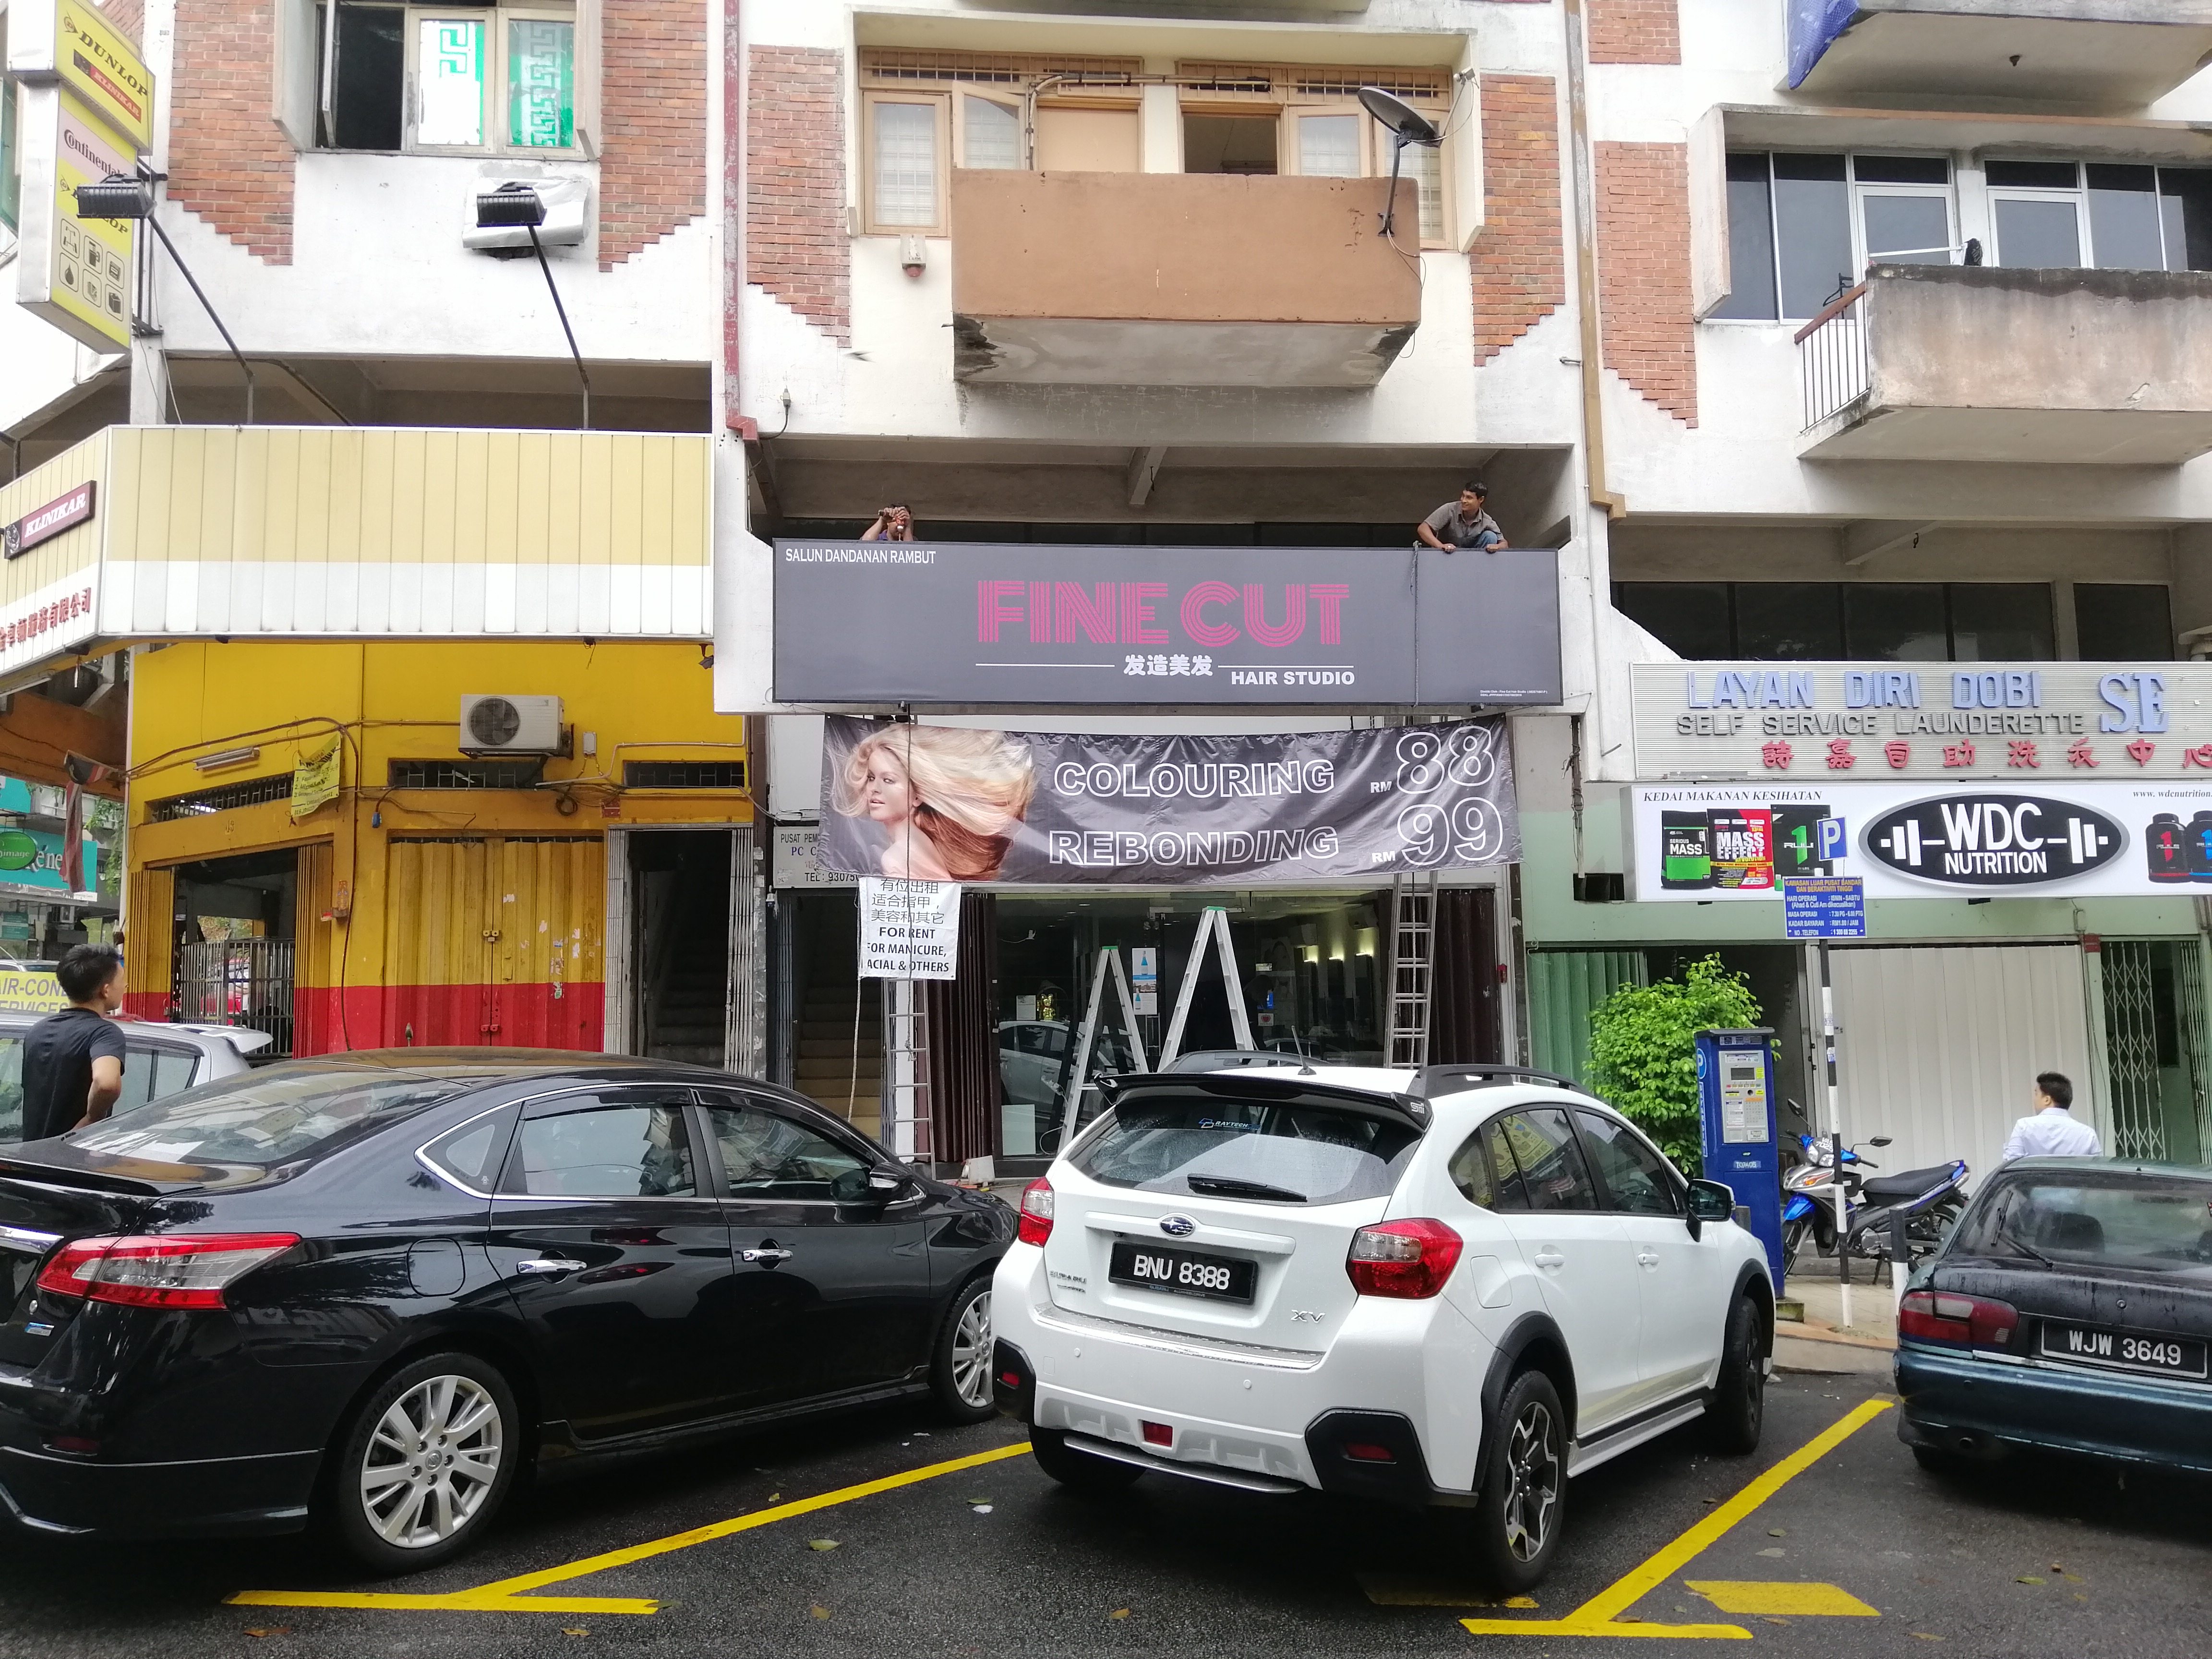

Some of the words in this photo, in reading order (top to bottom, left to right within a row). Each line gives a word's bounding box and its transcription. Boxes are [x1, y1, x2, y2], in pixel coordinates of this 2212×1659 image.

[79, 30, 148, 96] DUNLOP
[93, 72, 140, 118] KLINIKAR
[24, 493, 86, 538] KLINIKAR
[785, 548, 823, 562] SALUN
[825, 549, 888, 564] DANDANAN
[890, 550, 936, 564] RAMBUT
[978, 580, 1169, 644] FINE
[1180, 580, 1349, 648] CUT
[1123, 654, 1213, 676] 发造美发
[1231, 672, 1278, 685] HAIR
[1283, 672, 1355, 685] STUDIO
[1688, 671, 1815, 709] LAYAN
[1845, 670, 1920, 709] DIRI
[1953, 671, 2041, 709] DOBI
[2099, 672, 2170, 733] SE
[1677, 714, 1746, 737] SELF
[1763, 713, 1878, 737] SERVICE
[1895, 713, 2085, 736] LAUNDERETTE
[1370, 781, 1392, 794] RM
[1395, 725, 1495, 794] 88
[1054, 759, 1334, 798] COLOURING
[1643, 792, 1683, 802] KEDAI
[1685, 792, 1750, 801] MAKANAN
[1752, 791, 1822, 801] KESIHATAN
[1371, 851, 1396, 863] RM
[1396, 797, 1503, 865] 99
[1941, 802, 2044, 851] WDC
[781, 834, 801, 843] PUSAT
[1049, 827, 1339, 866] REBONDING
[1717, 831, 1765, 847] MASS
[1823, 820, 1840, 858] P
[792, 847, 804, 856] PC
[1670, 844, 1703, 854] MASS
[1717, 846, 1765, 860] EFFECT
[1945, 852, 2047, 874] NUTRITION
[880, 878, 939, 894] 有位出租
[871, 909, 944, 924] 美容和其它
[879, 927, 905, 937] FOR
[908, 928, 935, 938] RENT
[888, 944, 947, 957] MANICURE,
[866, 959, 895, 970] ACIAL
[898, 961, 906, 971] &
[910, 961, 949, 972] OTHERS
[0, 978, 67, 996] IR-CON
[1050, 1270, 1086, 1284] SUBARU
[1134, 1255, 1173, 1280] BNU
[1179, 1262, 1230, 1290] 8388
[1291, 1309, 1326, 1323] XV
[2068, 1330, 2113, 1356] WJW
[2122, 1338, 2181, 1365] 3649
